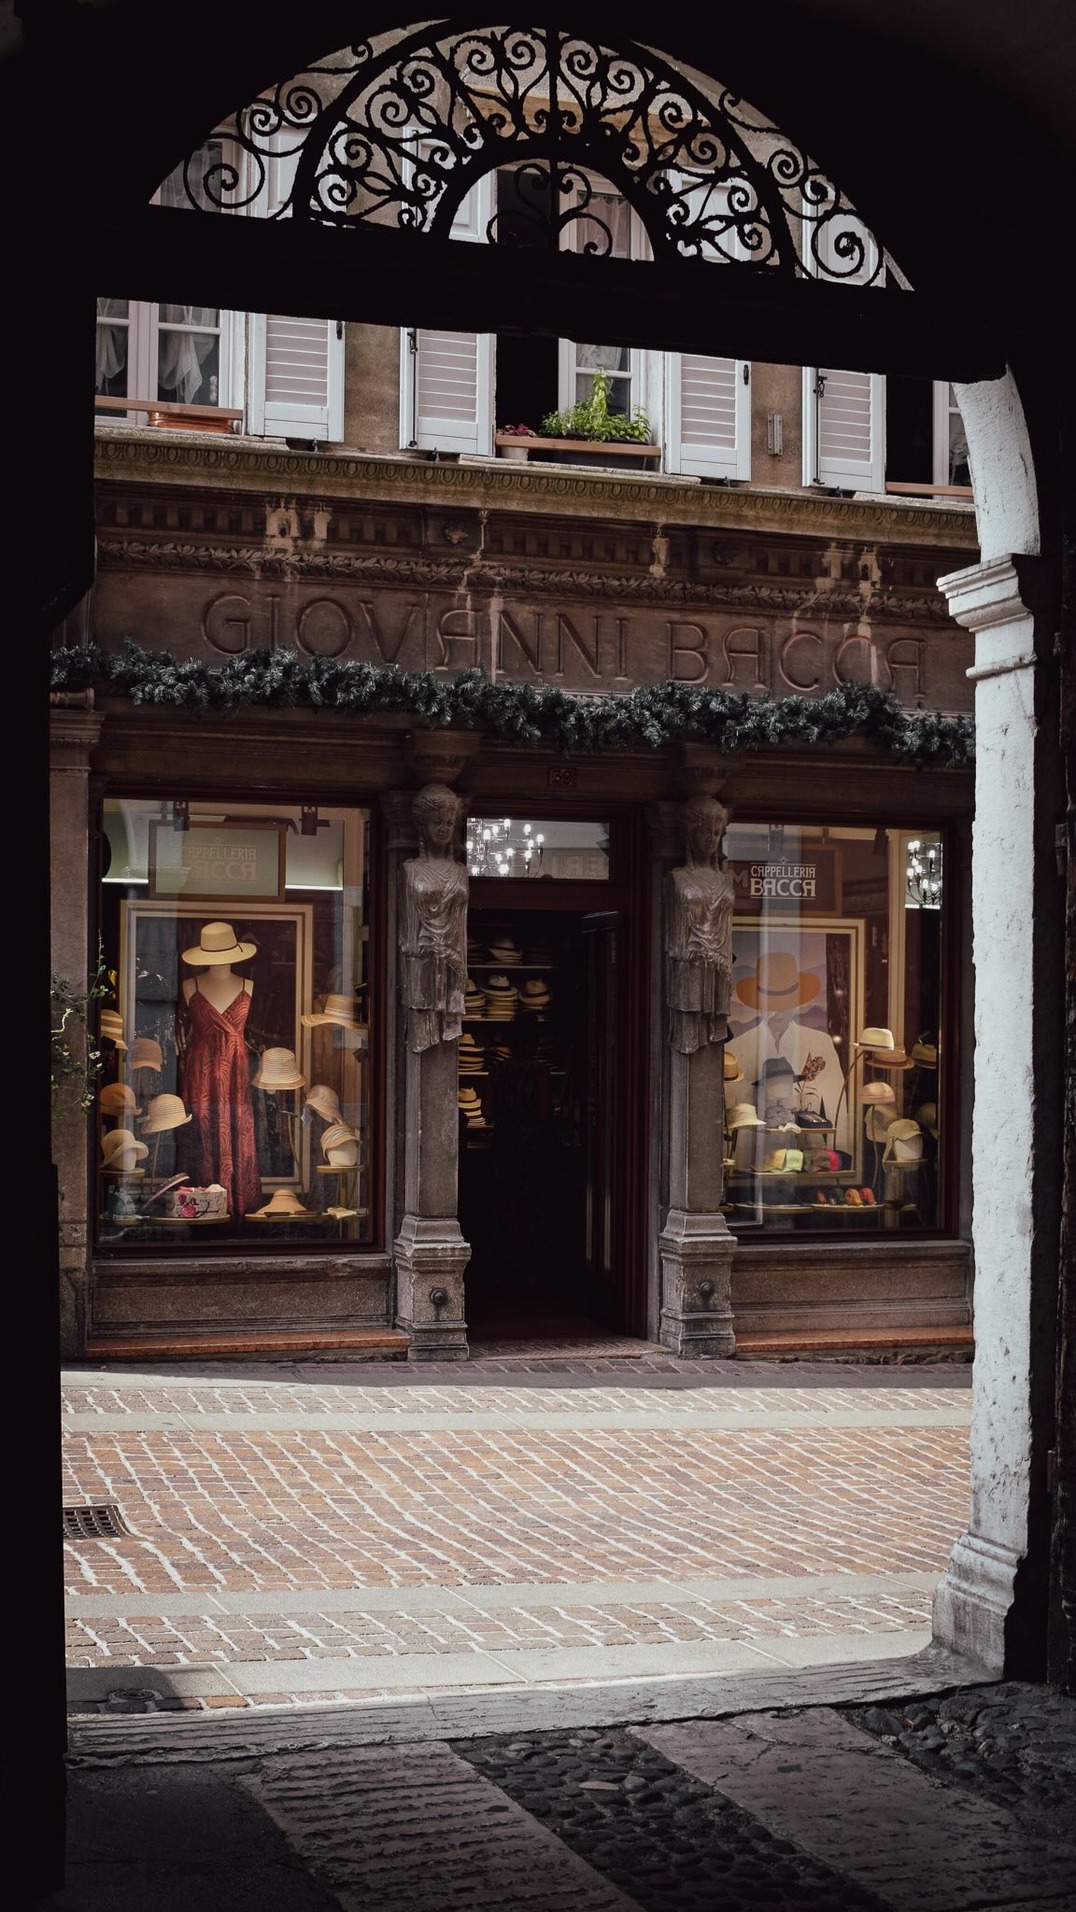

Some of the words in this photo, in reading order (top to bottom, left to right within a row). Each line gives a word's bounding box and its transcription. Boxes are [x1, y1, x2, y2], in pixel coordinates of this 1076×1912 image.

[201, 591, 629, 681] GIOVANNI
[665, 621, 926, 699] BACCA
[750, 866, 816, 879] CAPPELLERIA
[749, 878, 817, 897] BACCA
